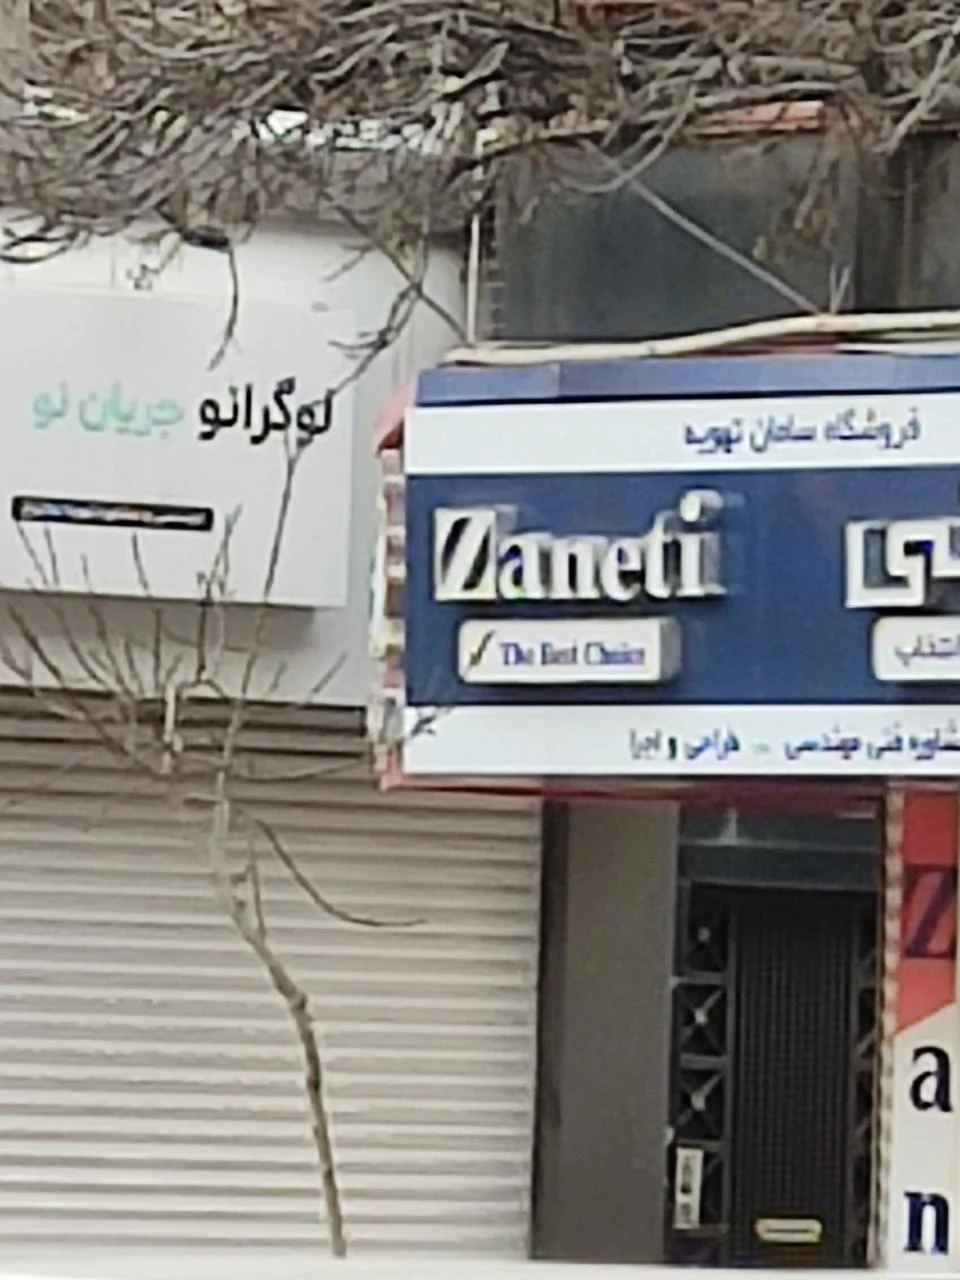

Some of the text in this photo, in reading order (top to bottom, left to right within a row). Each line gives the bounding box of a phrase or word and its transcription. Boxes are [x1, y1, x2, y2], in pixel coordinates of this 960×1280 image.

[78, 381, 184, 439] جریان
[198, 377, 334, 447] لوگرانو
[824, 406, 920, 450] فروشگاه
[434, 489, 727, 601] Zaneti
[499, 638, 646, 667] The Best Choice
